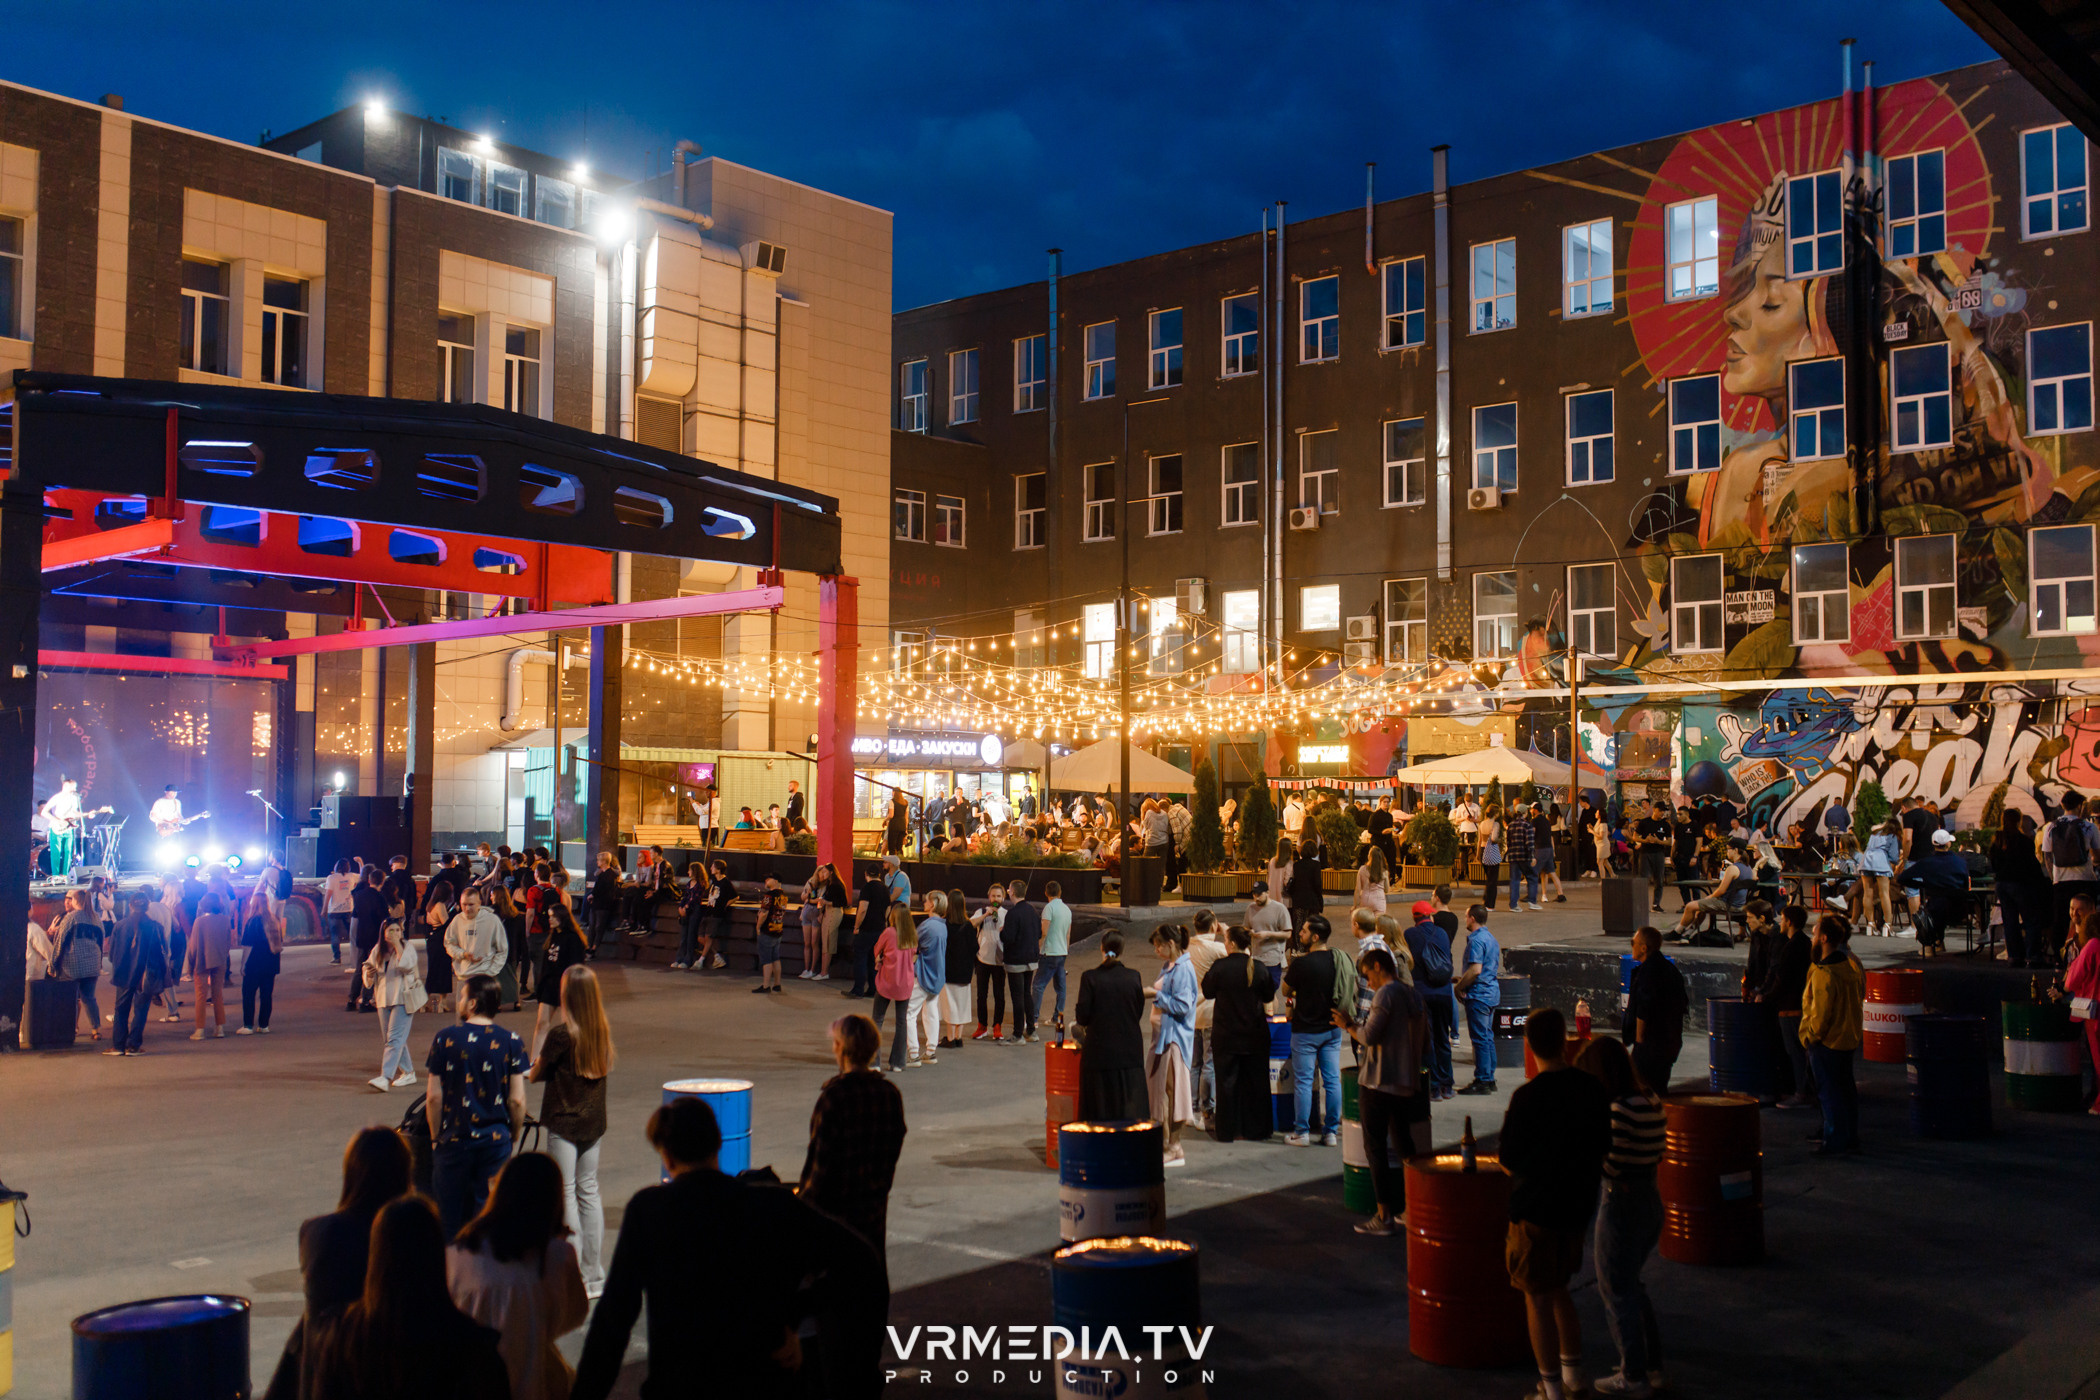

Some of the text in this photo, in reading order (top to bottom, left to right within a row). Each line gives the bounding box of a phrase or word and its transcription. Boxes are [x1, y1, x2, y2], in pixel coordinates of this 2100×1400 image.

[1886, 324, 1905, 332] BLACK
[1884, 331, 1907, 339] TUESDAY
[889, 570, 941, 589] ЦИЯ
[1726, 591, 1774, 603] MAN ON THE
[1750, 601, 1774, 611] MOON
[851, 738, 977, 756] ИВО ЕДА ЗАКУСКИ
[1739, 767, 1764, 787] WHO IS
